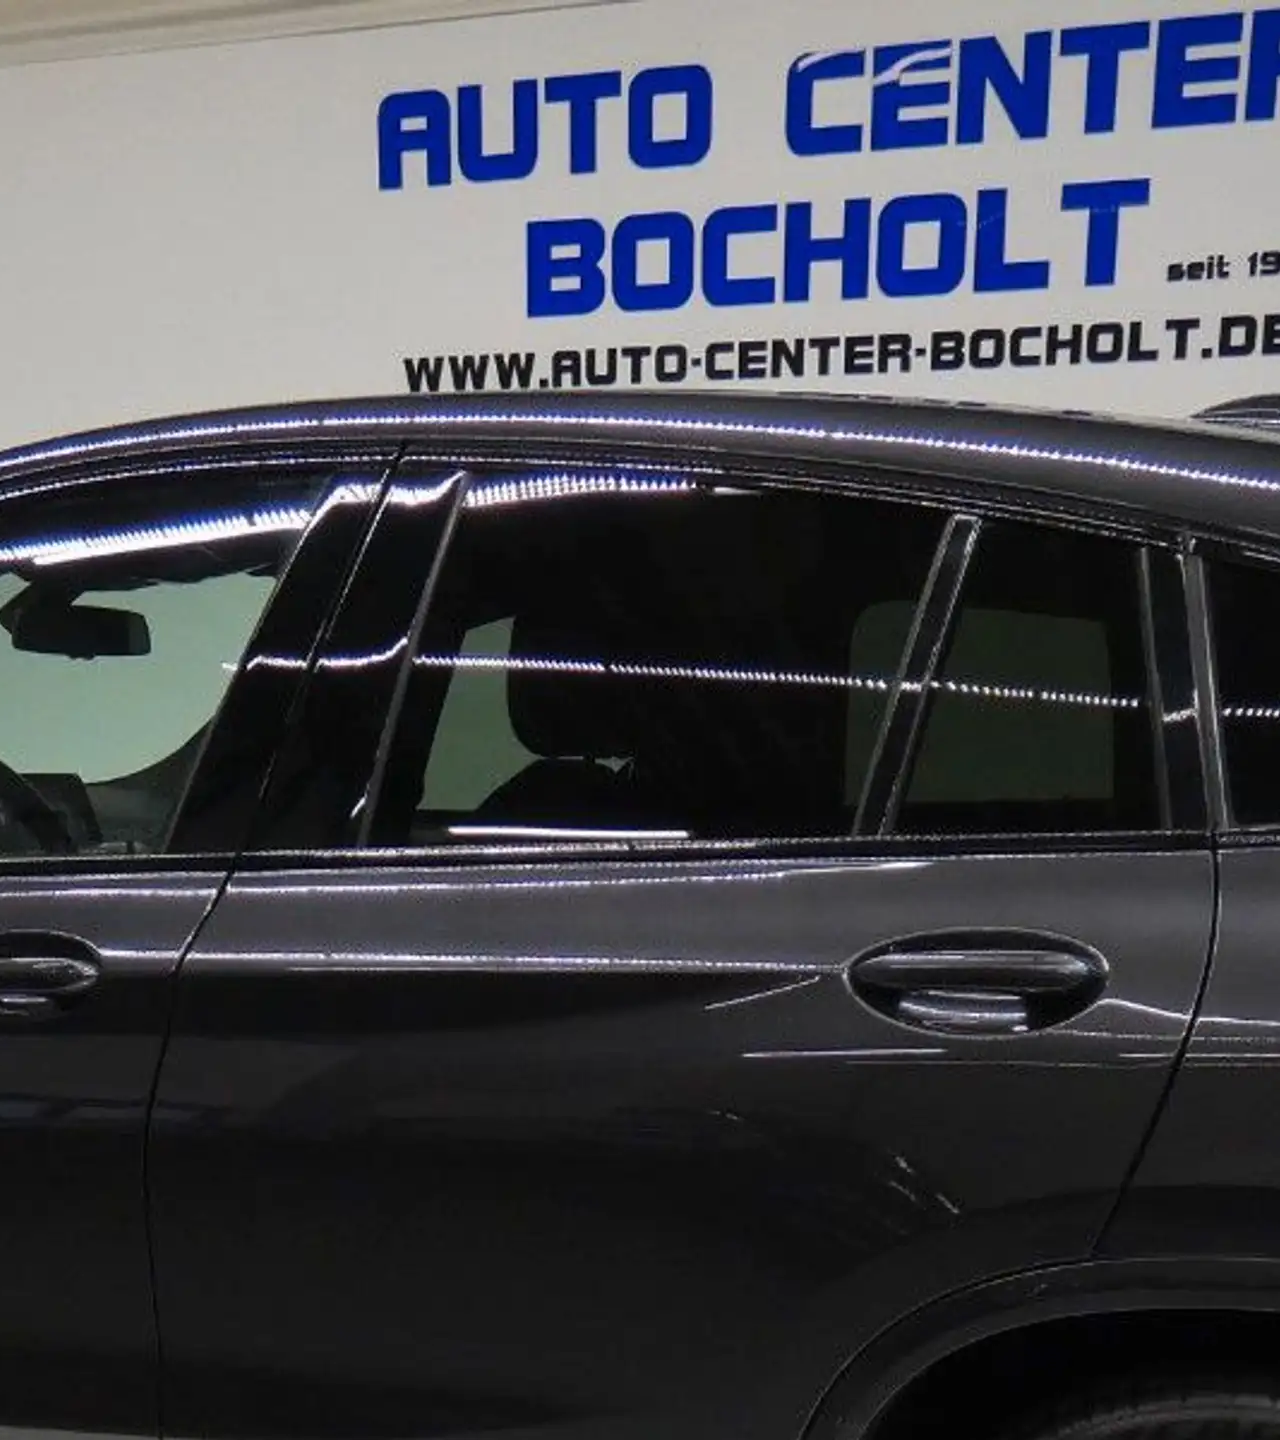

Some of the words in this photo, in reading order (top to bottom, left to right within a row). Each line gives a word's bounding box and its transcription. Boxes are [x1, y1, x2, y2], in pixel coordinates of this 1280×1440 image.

[376, 63, 714, 191] AUTO
[525, 177, 1151, 319] BOCHOLT
[1165, 254, 1231, 283] seit
